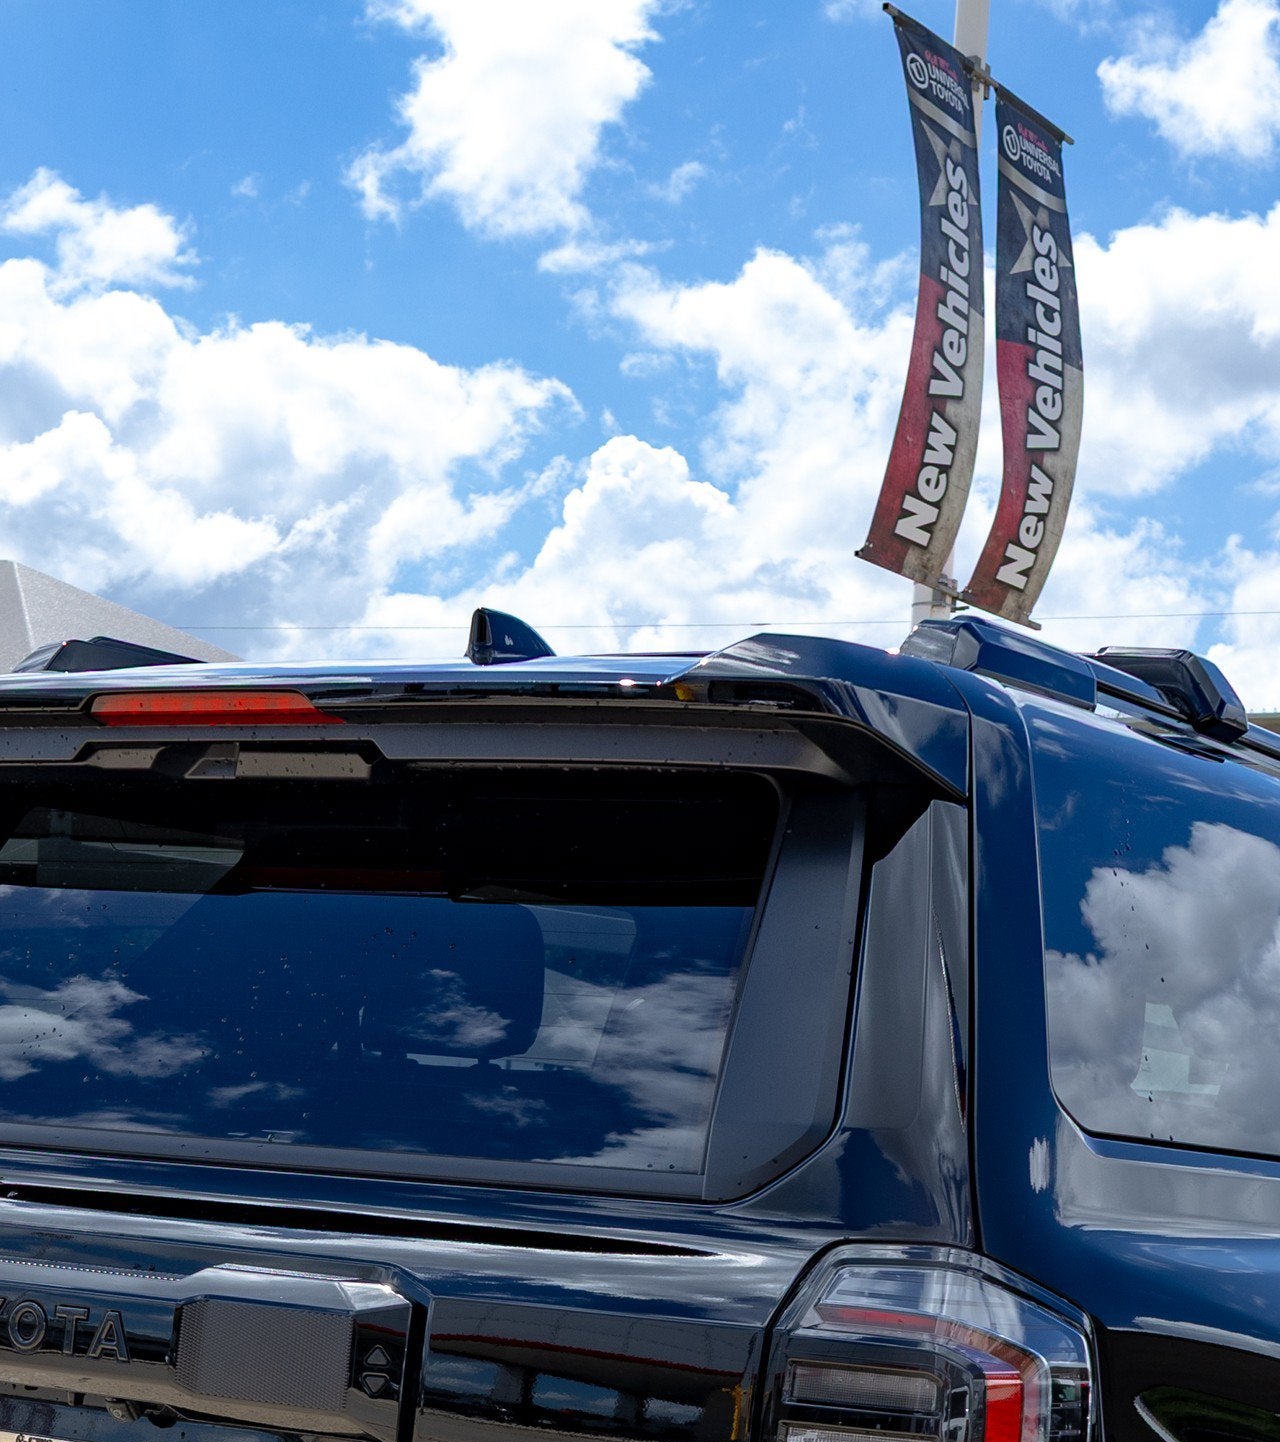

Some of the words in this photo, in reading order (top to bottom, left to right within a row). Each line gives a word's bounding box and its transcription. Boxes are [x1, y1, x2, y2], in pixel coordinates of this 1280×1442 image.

[927, 62, 970, 110] UNIVERSAL
[929, 80, 964, 114] TOYOTA
[1019, 135, 1061, 178] UNIVERSAL
[1020, 152, 1052, 184] TOYOTA
[894, 412, 958, 548] New
[928, 158, 971, 397] Vehicles
[995, 464, 1054, 590] New
[1026, 225, 1063, 450] Vehicles
